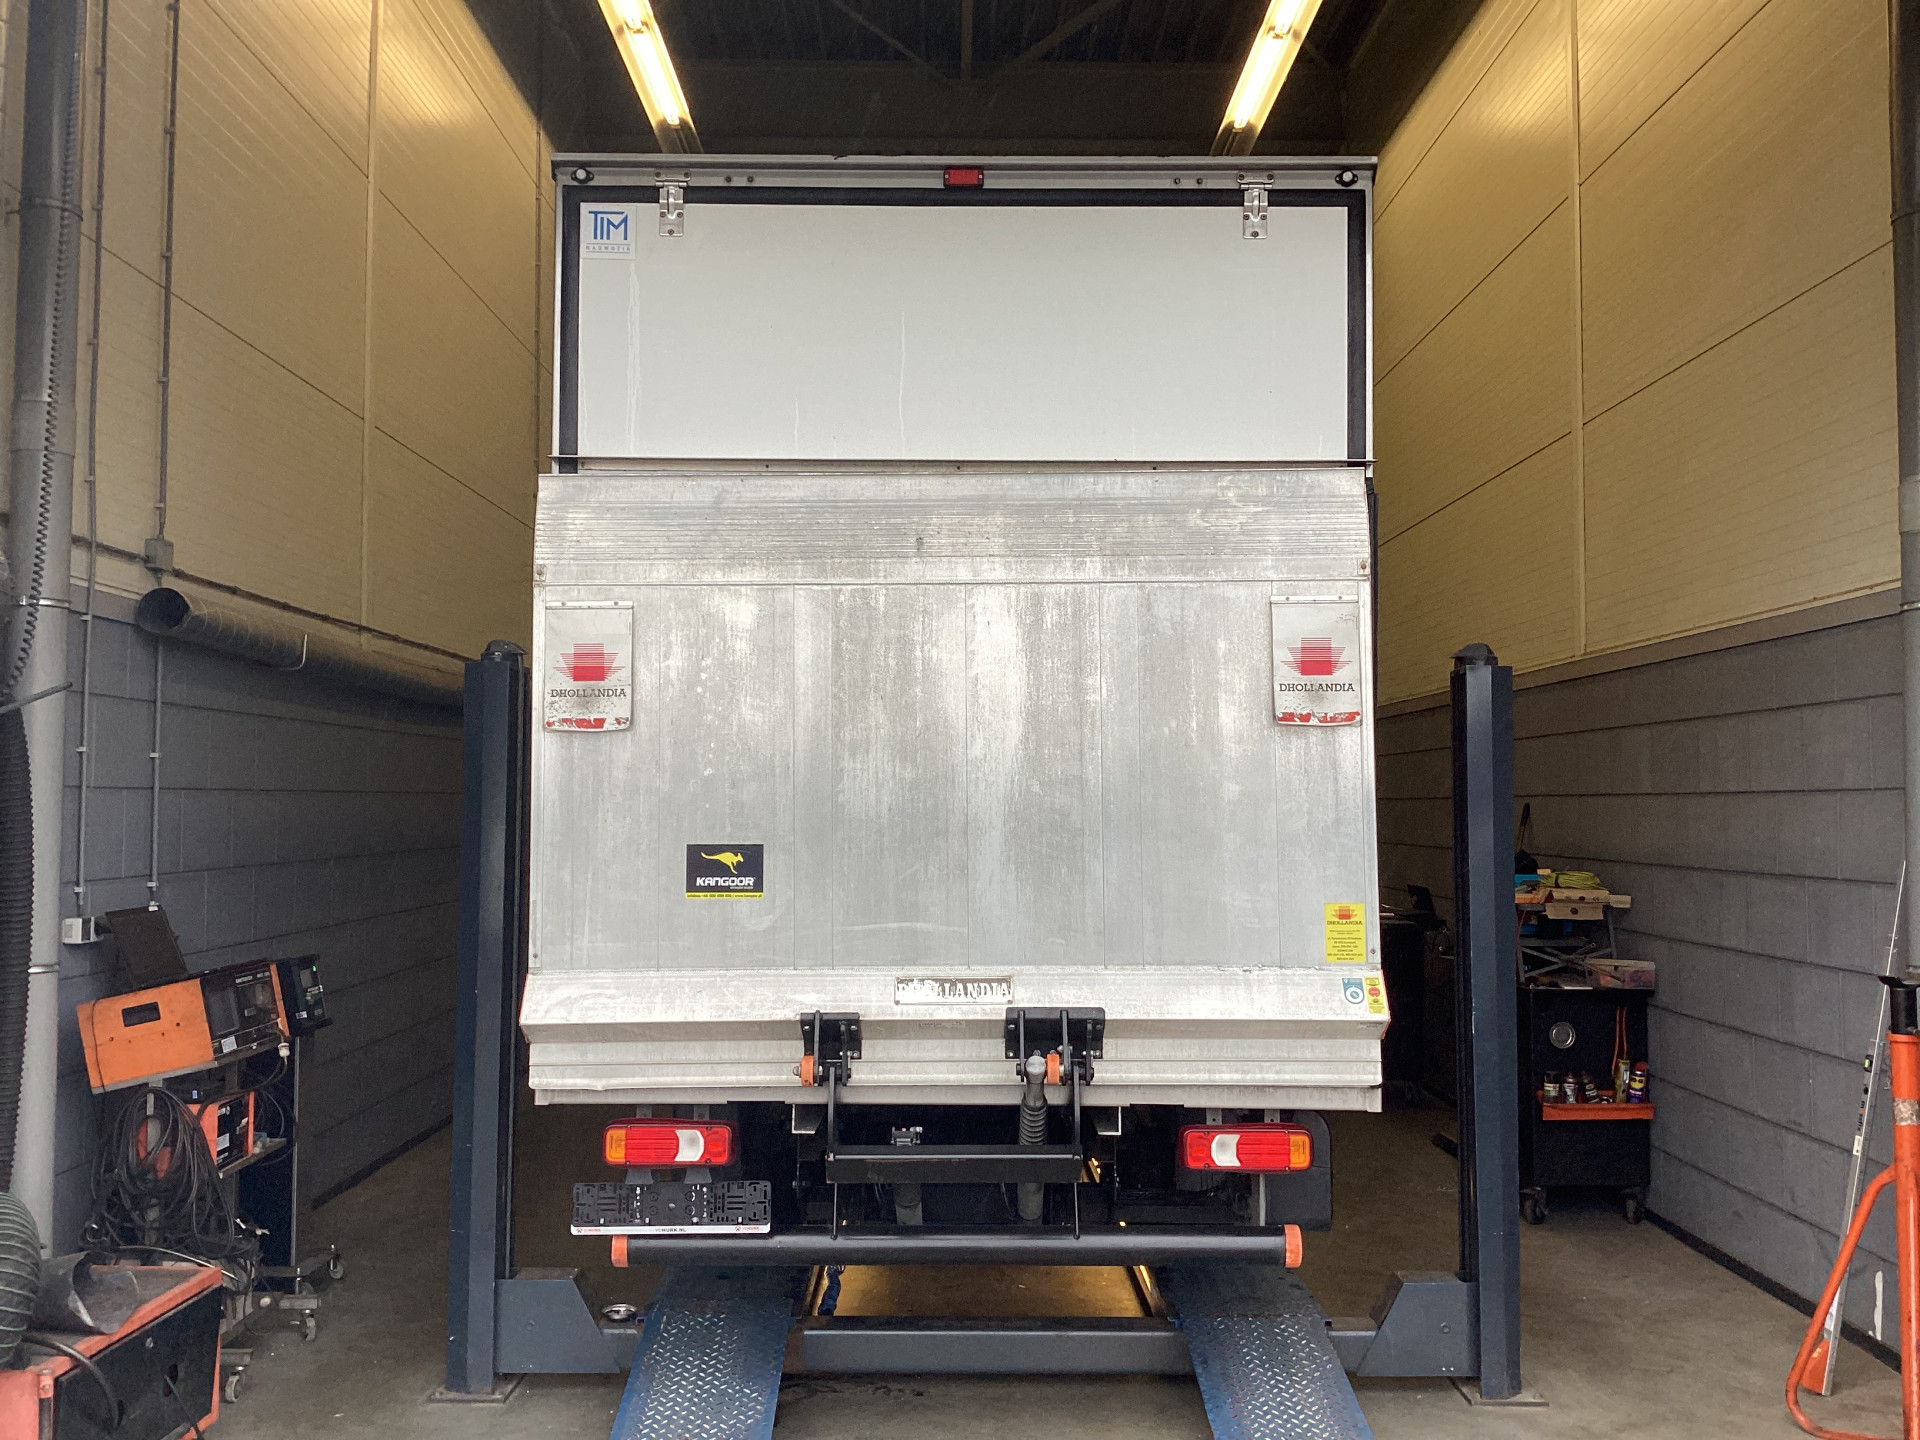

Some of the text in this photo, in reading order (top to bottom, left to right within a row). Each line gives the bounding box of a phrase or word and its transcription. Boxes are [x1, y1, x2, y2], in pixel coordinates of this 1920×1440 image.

[588, 210, 628, 241] TIM
[1279, 682, 1355, 692] DHOLLANDIA
[549, 688, 626, 698] DHOLLANDIA
[696, 876, 754, 887] KANGOOR
